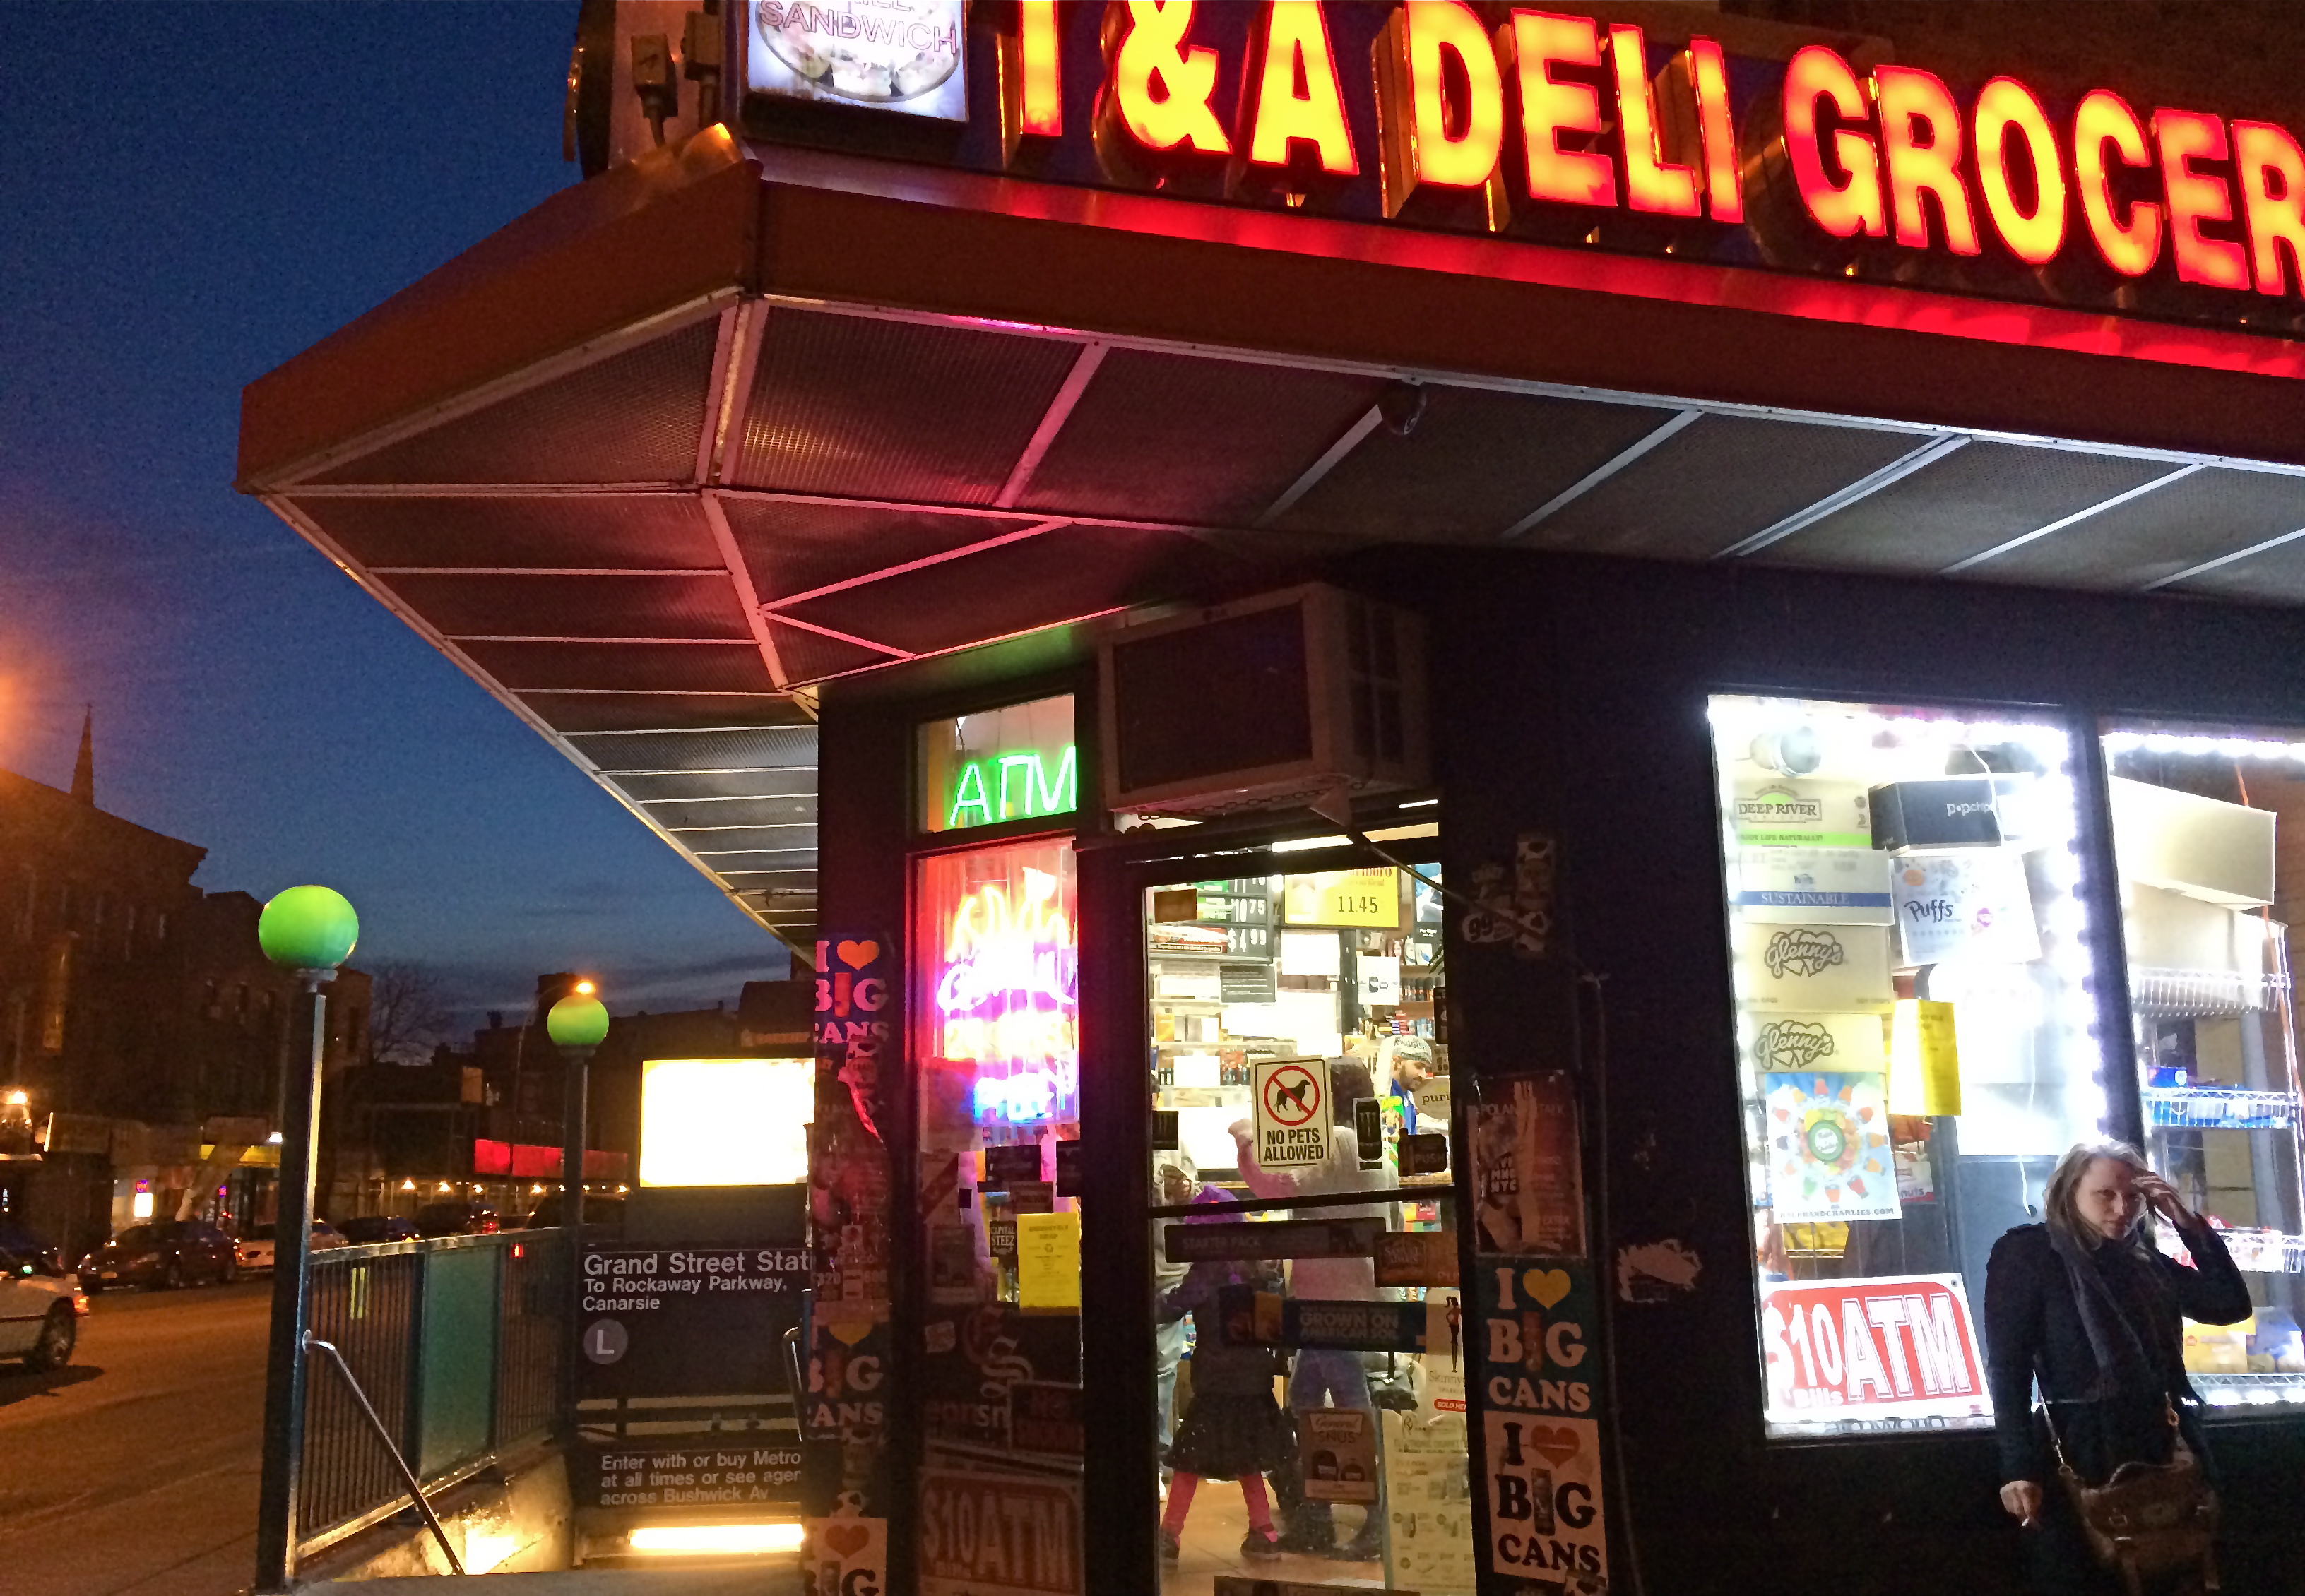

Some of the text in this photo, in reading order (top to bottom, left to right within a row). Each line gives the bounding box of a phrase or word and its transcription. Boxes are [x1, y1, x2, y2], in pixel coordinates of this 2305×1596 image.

[760, 1, 957, 54] SANDWICH
[1250, 0, 1361, 176] A
[1408, 0, 1744, 224] DELI
[1782, 44, 2305, 302] GROCER
[949, 746, 1077, 826] ATM
[1738, 803, 1818, 816] DEEP RIVER
[1946, 802, 1992, 817] popchip
[1338, 895, 1377, 914] 11.45
[1761, 892, 1850, 905] SUSTAINABLE
[1903, 898, 1953, 924] Puffs
[814, 1021, 890, 1044] ANS
[1266, 1128, 1320, 1145] NO PETS
[1264, 1144, 1325, 1162] ALLOWED
[1415, 1153, 1446, 1164] PUSH
[990, 1226, 1016, 1235] CAPITAL
[990, 1234, 1015, 1246] STEEZ
[583, 1253, 658, 1275] Grand
[669, 1251, 745, 1274] Street
[583, 1275, 788, 1294] To Rockaway Parkway,
[1495, 1267, 1517, 1310] I
[582, 1296, 660, 1311] Canarsie
[1299, 1311, 1399, 1329] GROWN ON
[596, 1330, 615, 1354] L
[1841, 1292, 1972, 1402] ATM
[1488, 1376, 1591, 1412] CANS
[1793, 1388, 1844, 1408] Bills
[807, 1401, 885, 1427] ANS
[1437, 1401, 1454, 1410] SOLD
[1503, 1422, 1524, 1467] I
[601, 1451, 802, 1470] Enter with or buy Metro
[601, 1475, 617, 1488] at
[624, 1472, 642, 1487] all
[650, 1471, 694, 1487] times
[701, 1472, 719, 1484] or
[725, 1472, 756, 1484] see
[600, 1485, 769, 1506] across Bushwick Av
[977, 1489, 1072, 1588] ATM
[1498, 1533, 1601, 1575] CANS
